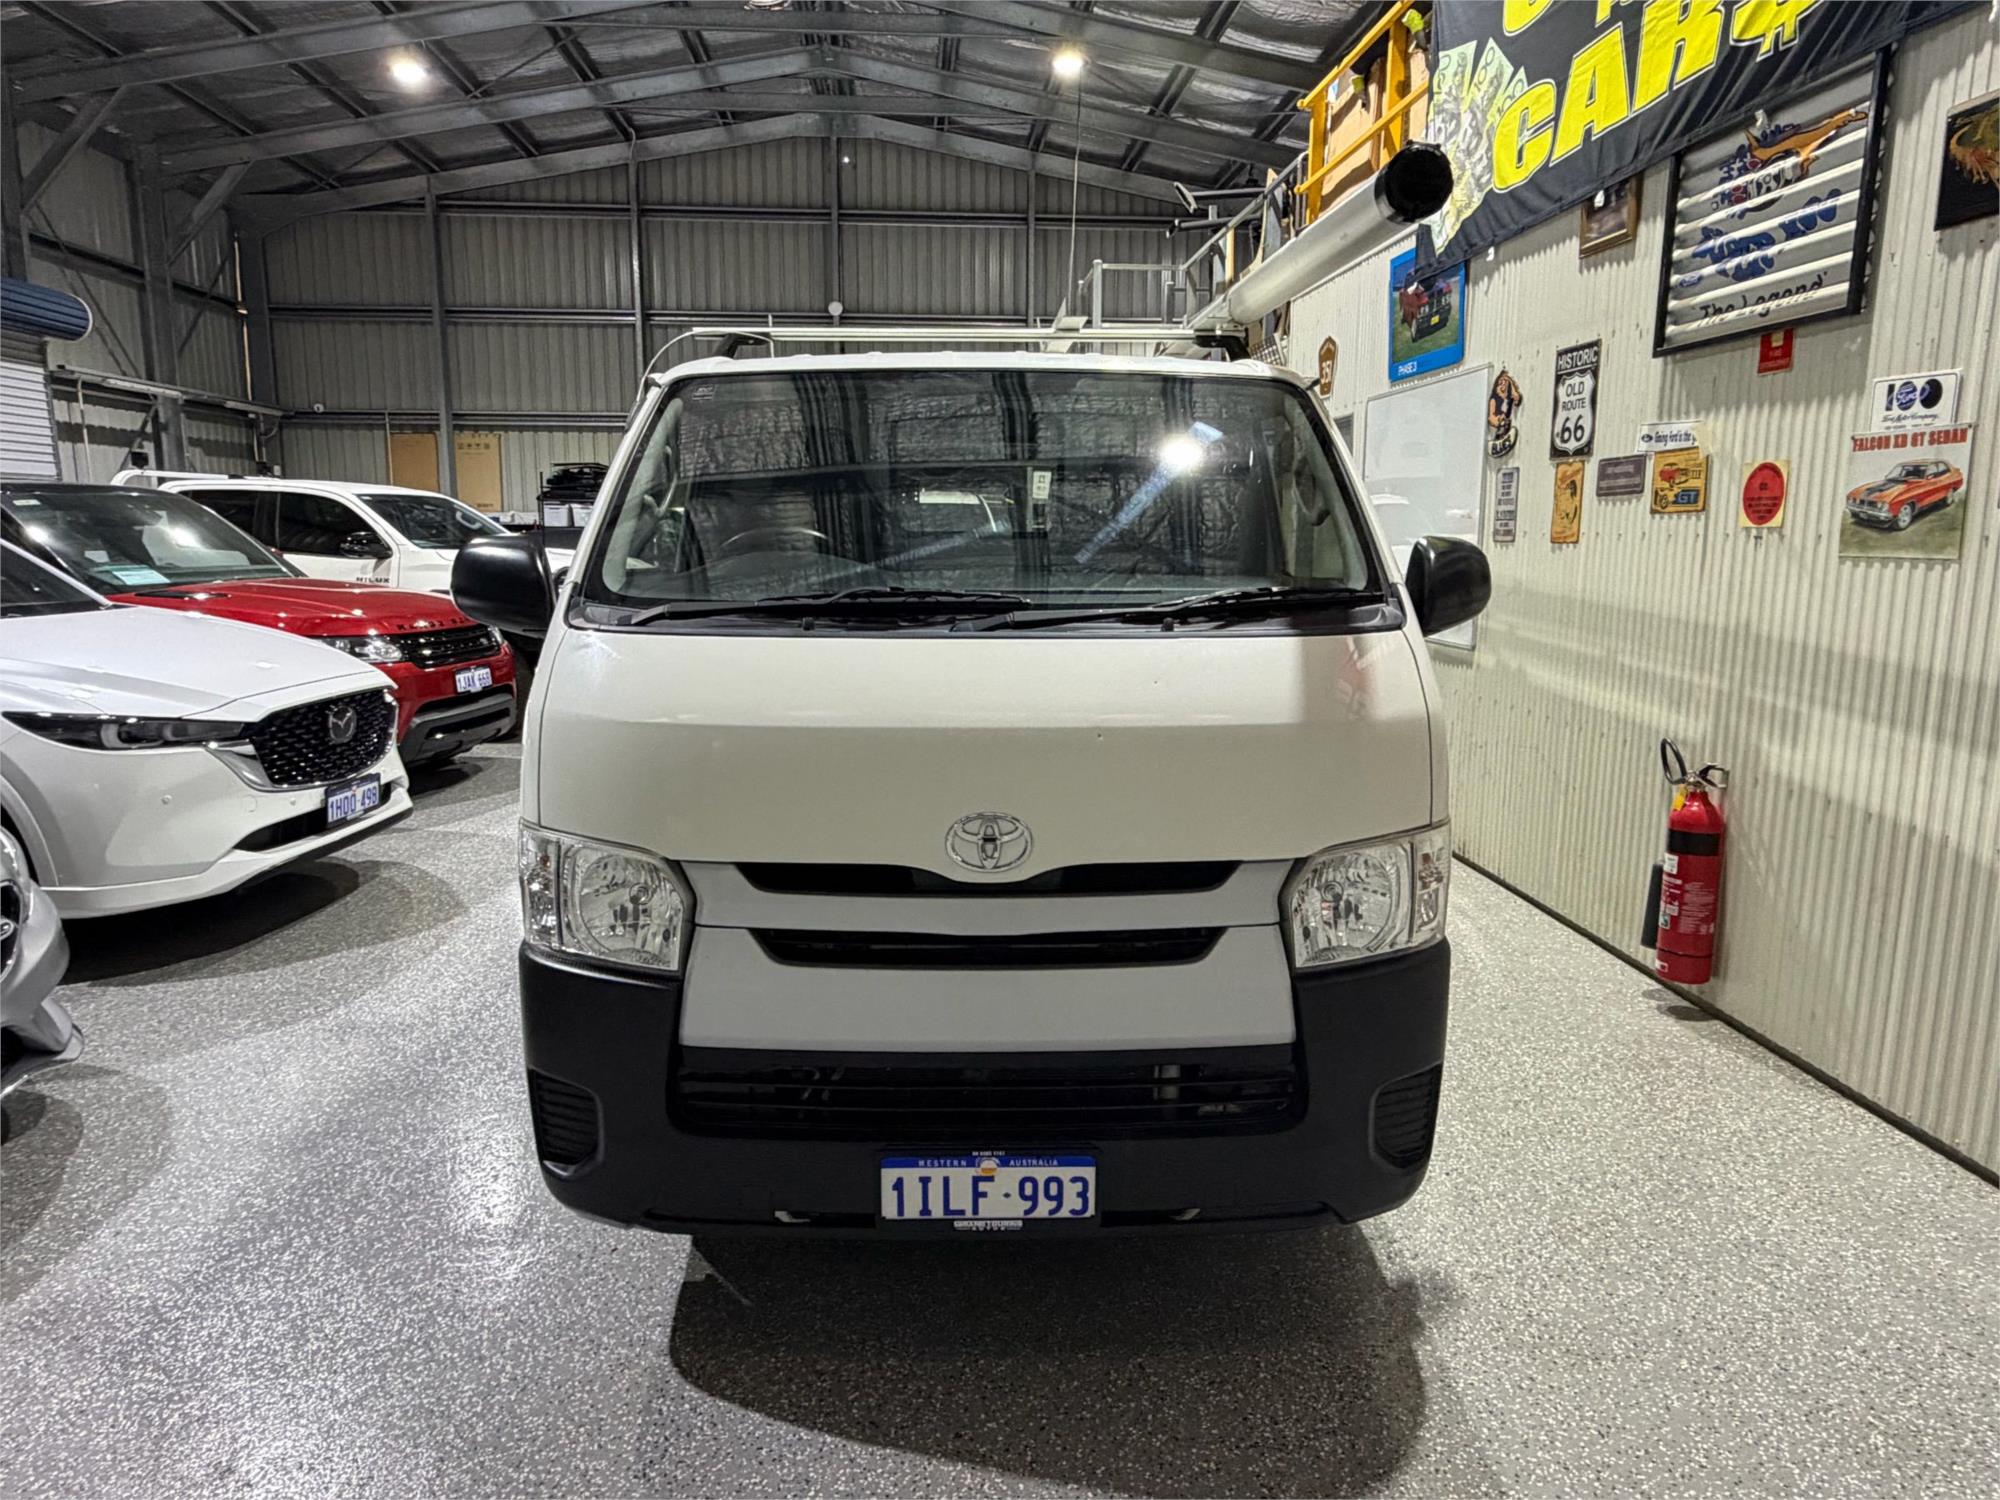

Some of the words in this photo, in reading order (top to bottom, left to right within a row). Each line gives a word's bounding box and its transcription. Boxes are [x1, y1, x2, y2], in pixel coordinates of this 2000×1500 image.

[1557, 346, 1599, 371] HISTORIC
[1565, 381, 1585, 398] OLD
[1885, 378, 1943, 412] 100
[1561, 397, 1587, 412] ROUTE
[1560, 414, 1585, 444] 66
[1852, 435, 1892, 452] FALCON
[1910, 431, 1926, 448] GT
[1928, 427, 1969, 446] SEDAN
[1677, 490, 1698, 503] GT
[356, 576, 390, 584] HILUX
[918, 1159, 967, 1168] WESTERN
[1009, 1158, 1059, 1167] AUSTRALIA
